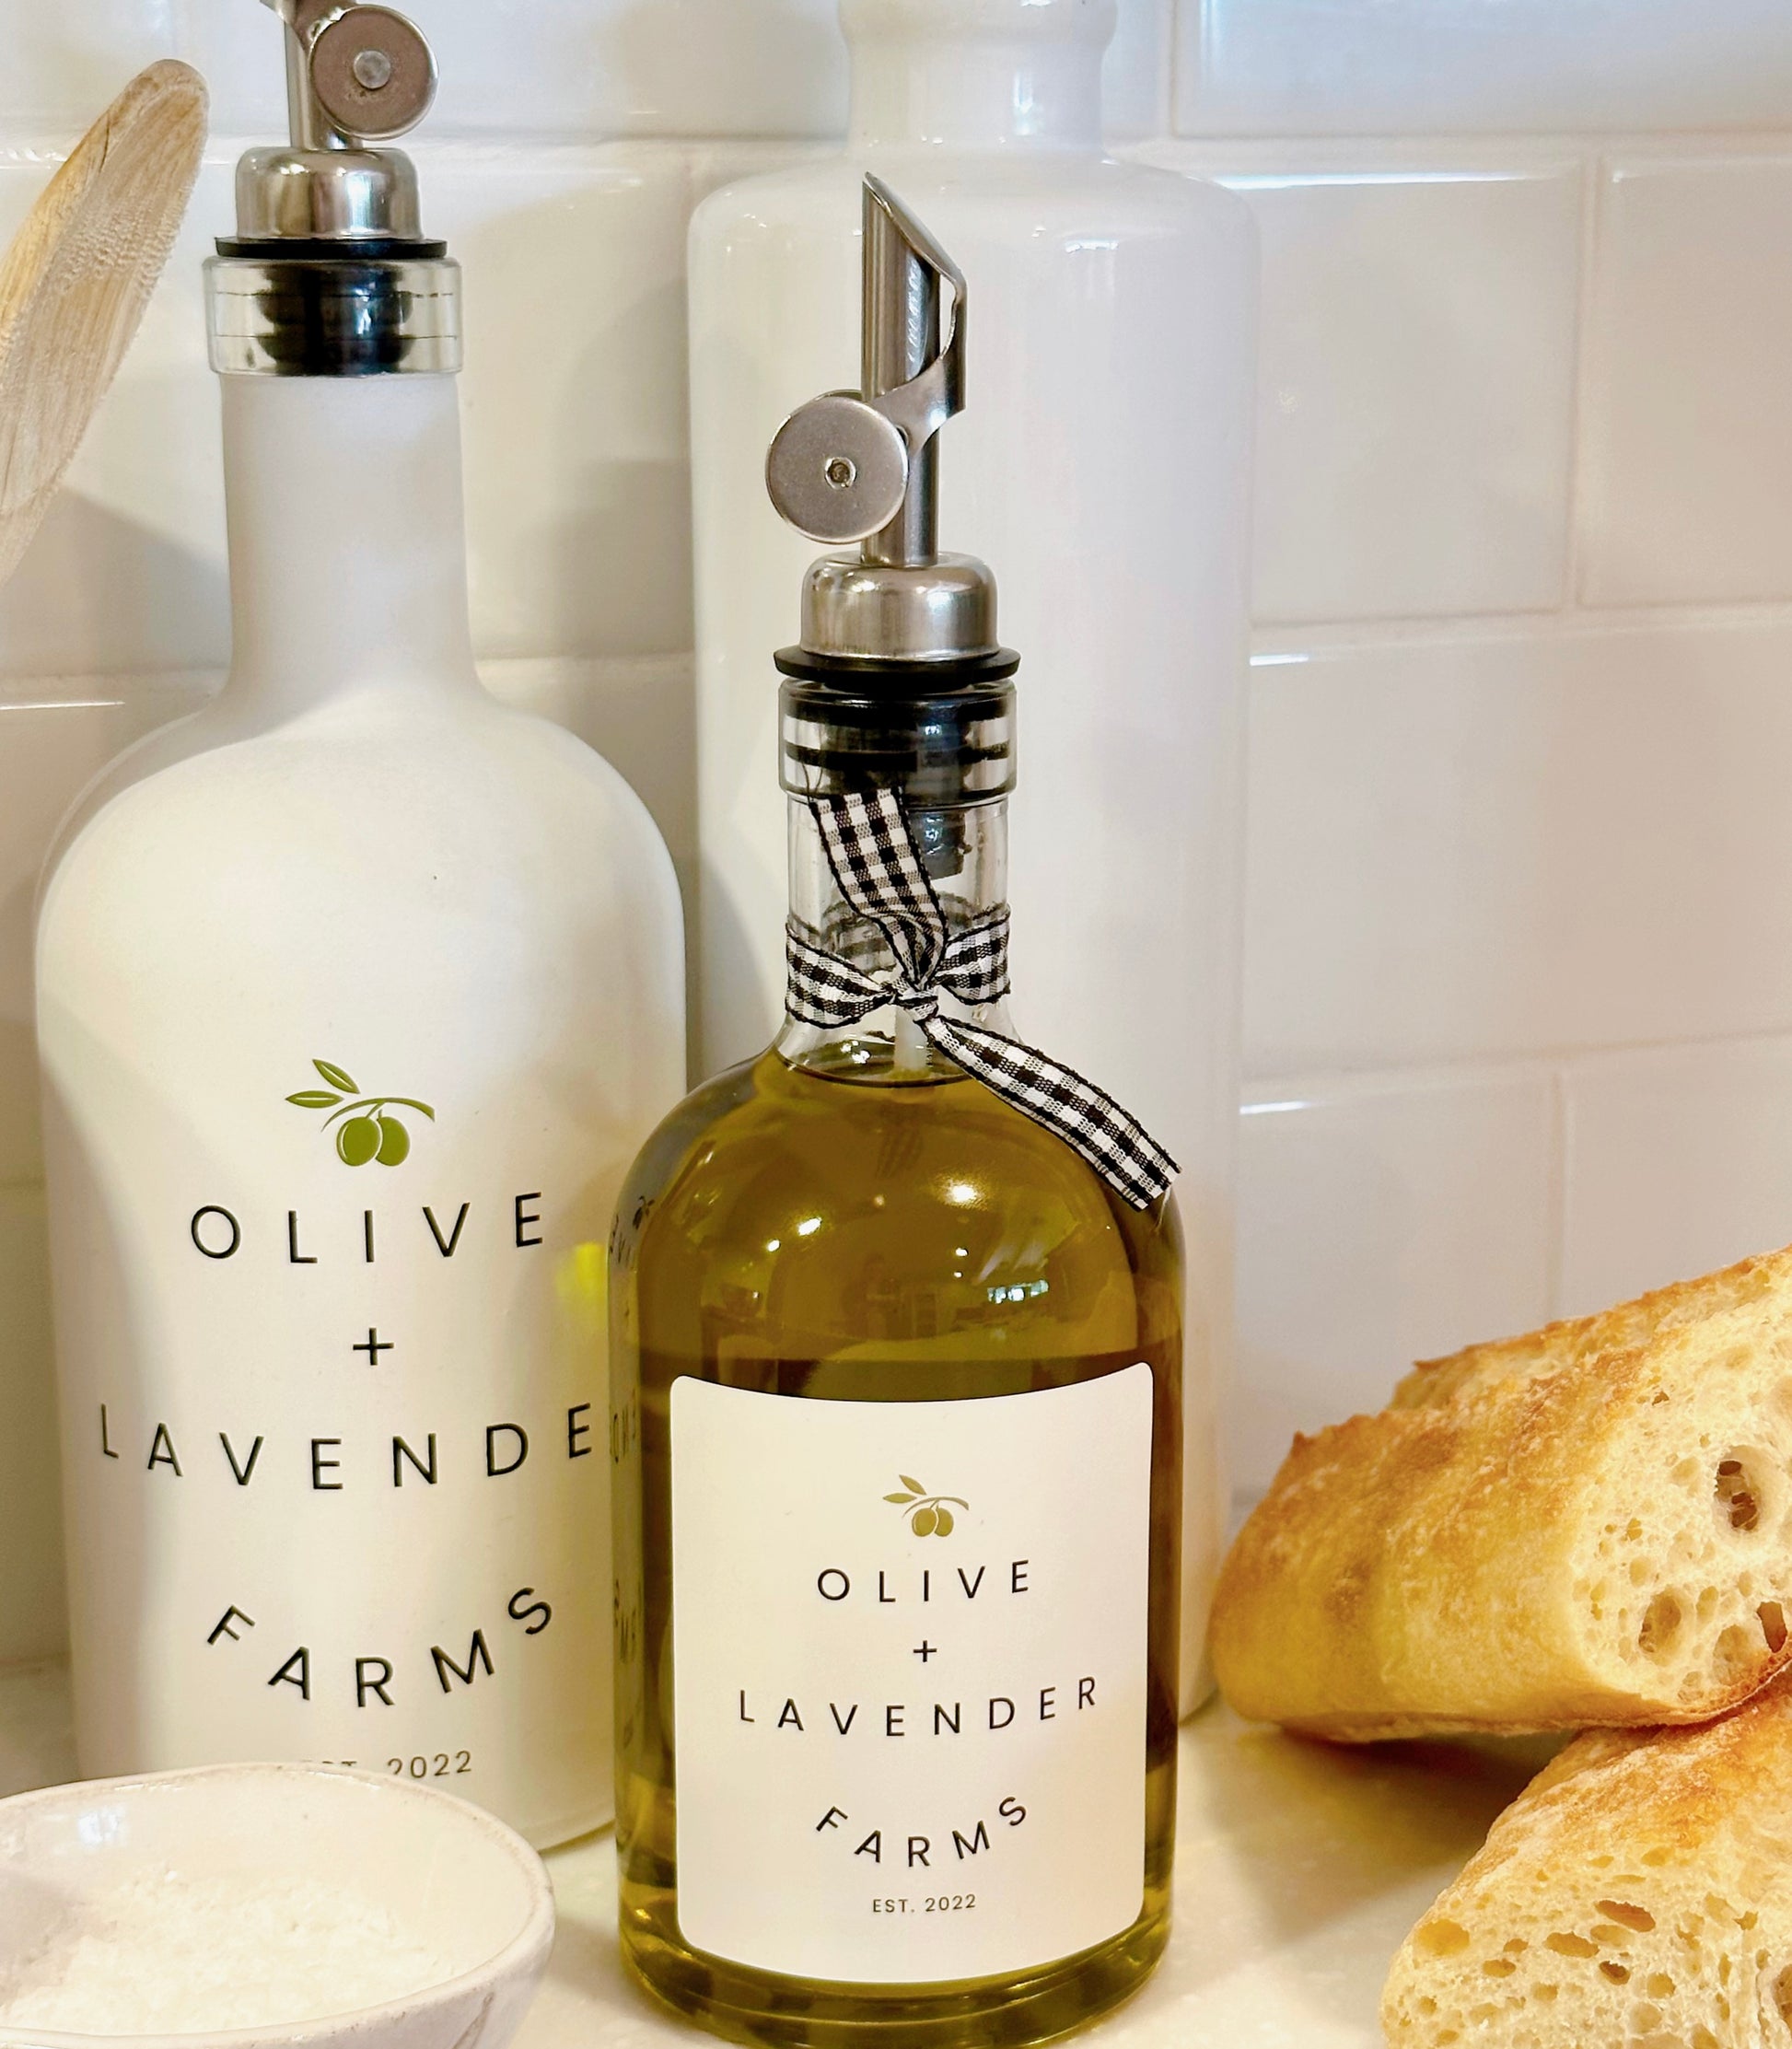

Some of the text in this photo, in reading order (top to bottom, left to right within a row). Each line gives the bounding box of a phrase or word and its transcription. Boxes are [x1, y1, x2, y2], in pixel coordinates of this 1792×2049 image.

[191, 1192, 543, 1263] OLIVE
[100, 1403, 592, 1489] LAVENDE
[817, 1560, 1029, 1602] OLIVE
[206, 1587, 553, 1707] FARMS
[739, 1676, 1096, 1737] LAVENDER
[816, 1796, 1027, 1868] FARMS
[872, 1893, 977, 1914] EST. 2022
